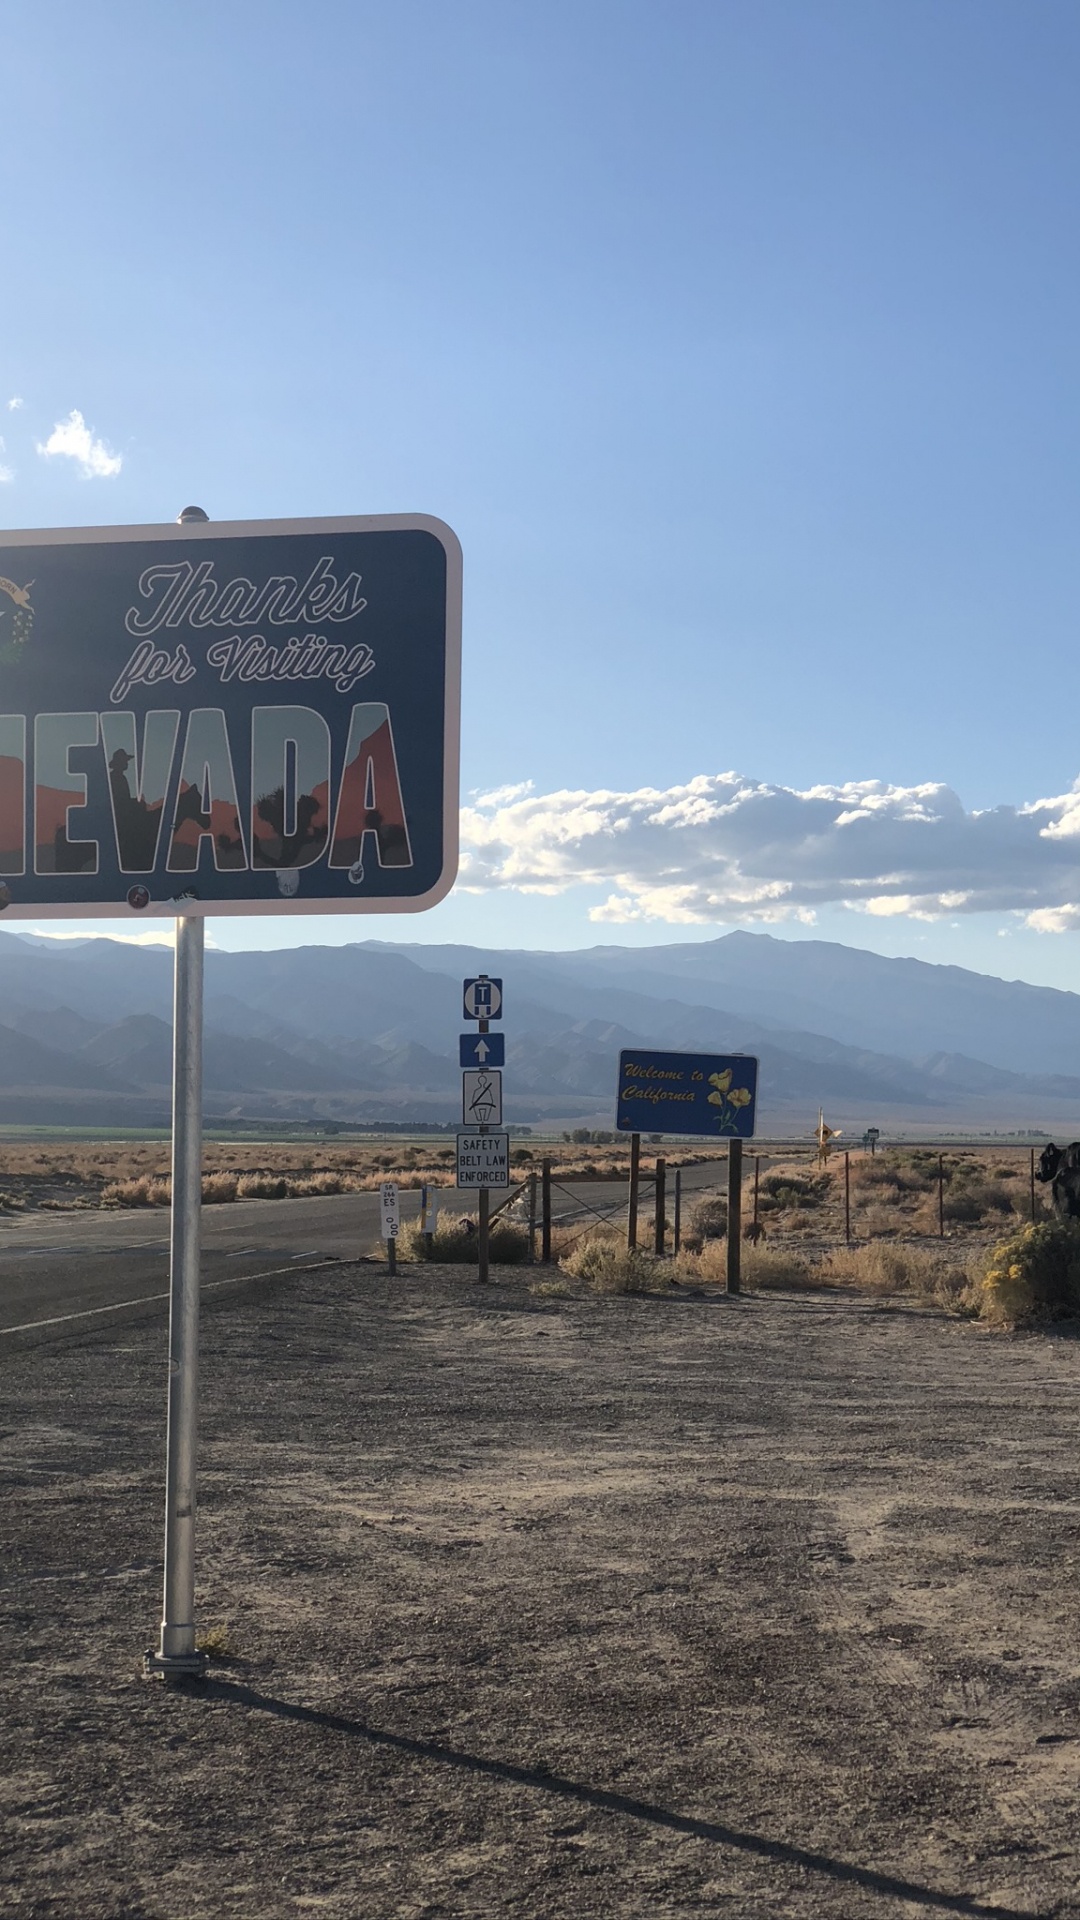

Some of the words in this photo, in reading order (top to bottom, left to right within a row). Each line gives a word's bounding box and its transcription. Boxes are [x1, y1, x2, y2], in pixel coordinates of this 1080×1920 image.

[125, 556, 367, 636] Thanks
[110, 640, 196, 703] for
[206, 634, 375, 692] Visiting
[624, 1063, 685, 1080] Welcome
[691, 1070, 704, 1081] to
[621, 1085, 696, 1104] California
[463, 1139, 500, 1150] SAFETY
[460, 1155, 481, 1166] BELT
[486, 1155, 506, 1166] LAW
[460, 1171, 506, 1182] ENFORCED
